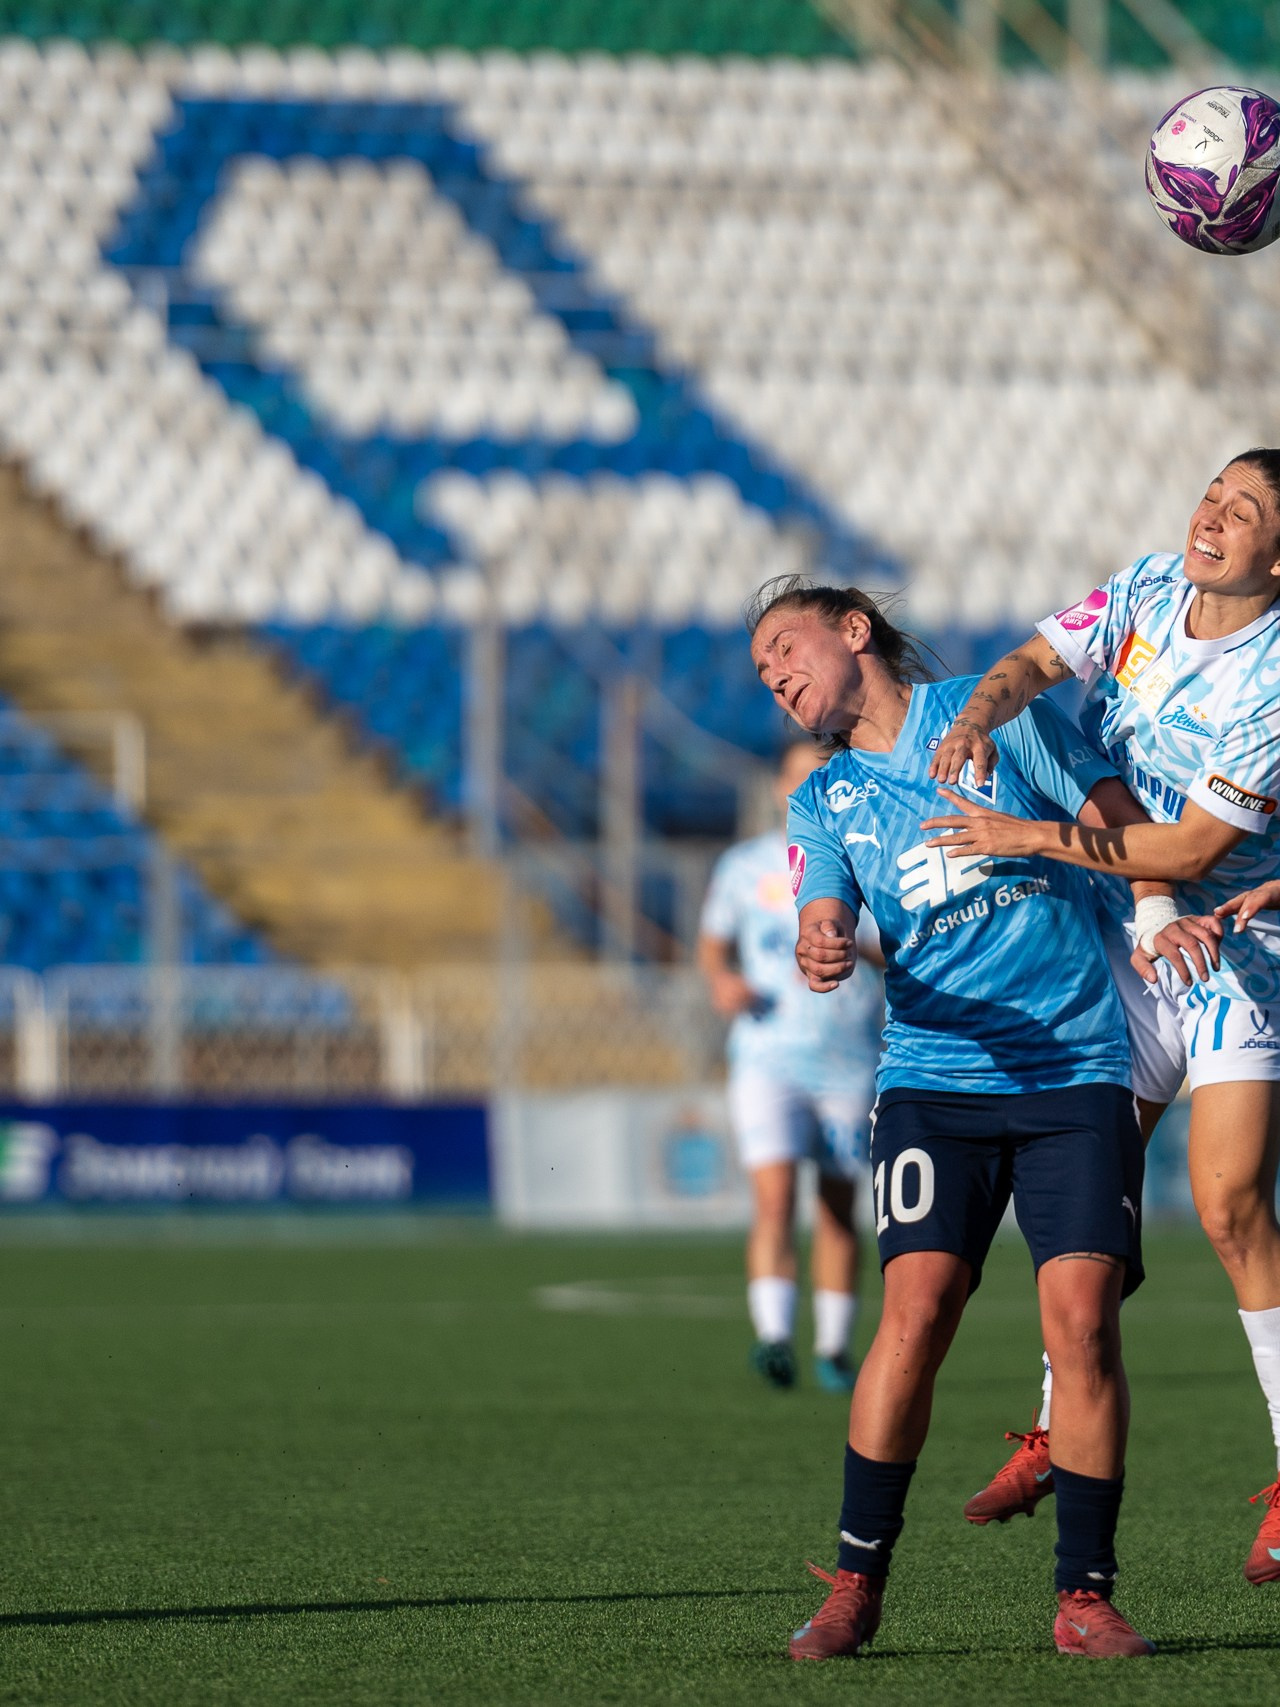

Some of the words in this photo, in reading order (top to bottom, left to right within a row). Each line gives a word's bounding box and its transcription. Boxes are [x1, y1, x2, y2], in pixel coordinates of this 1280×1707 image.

[1210, 778, 1266, 812] WINLINE
[1239, 1038, 1280, 1049] JÖGEL
[875, 1148, 935, 1237] 10
